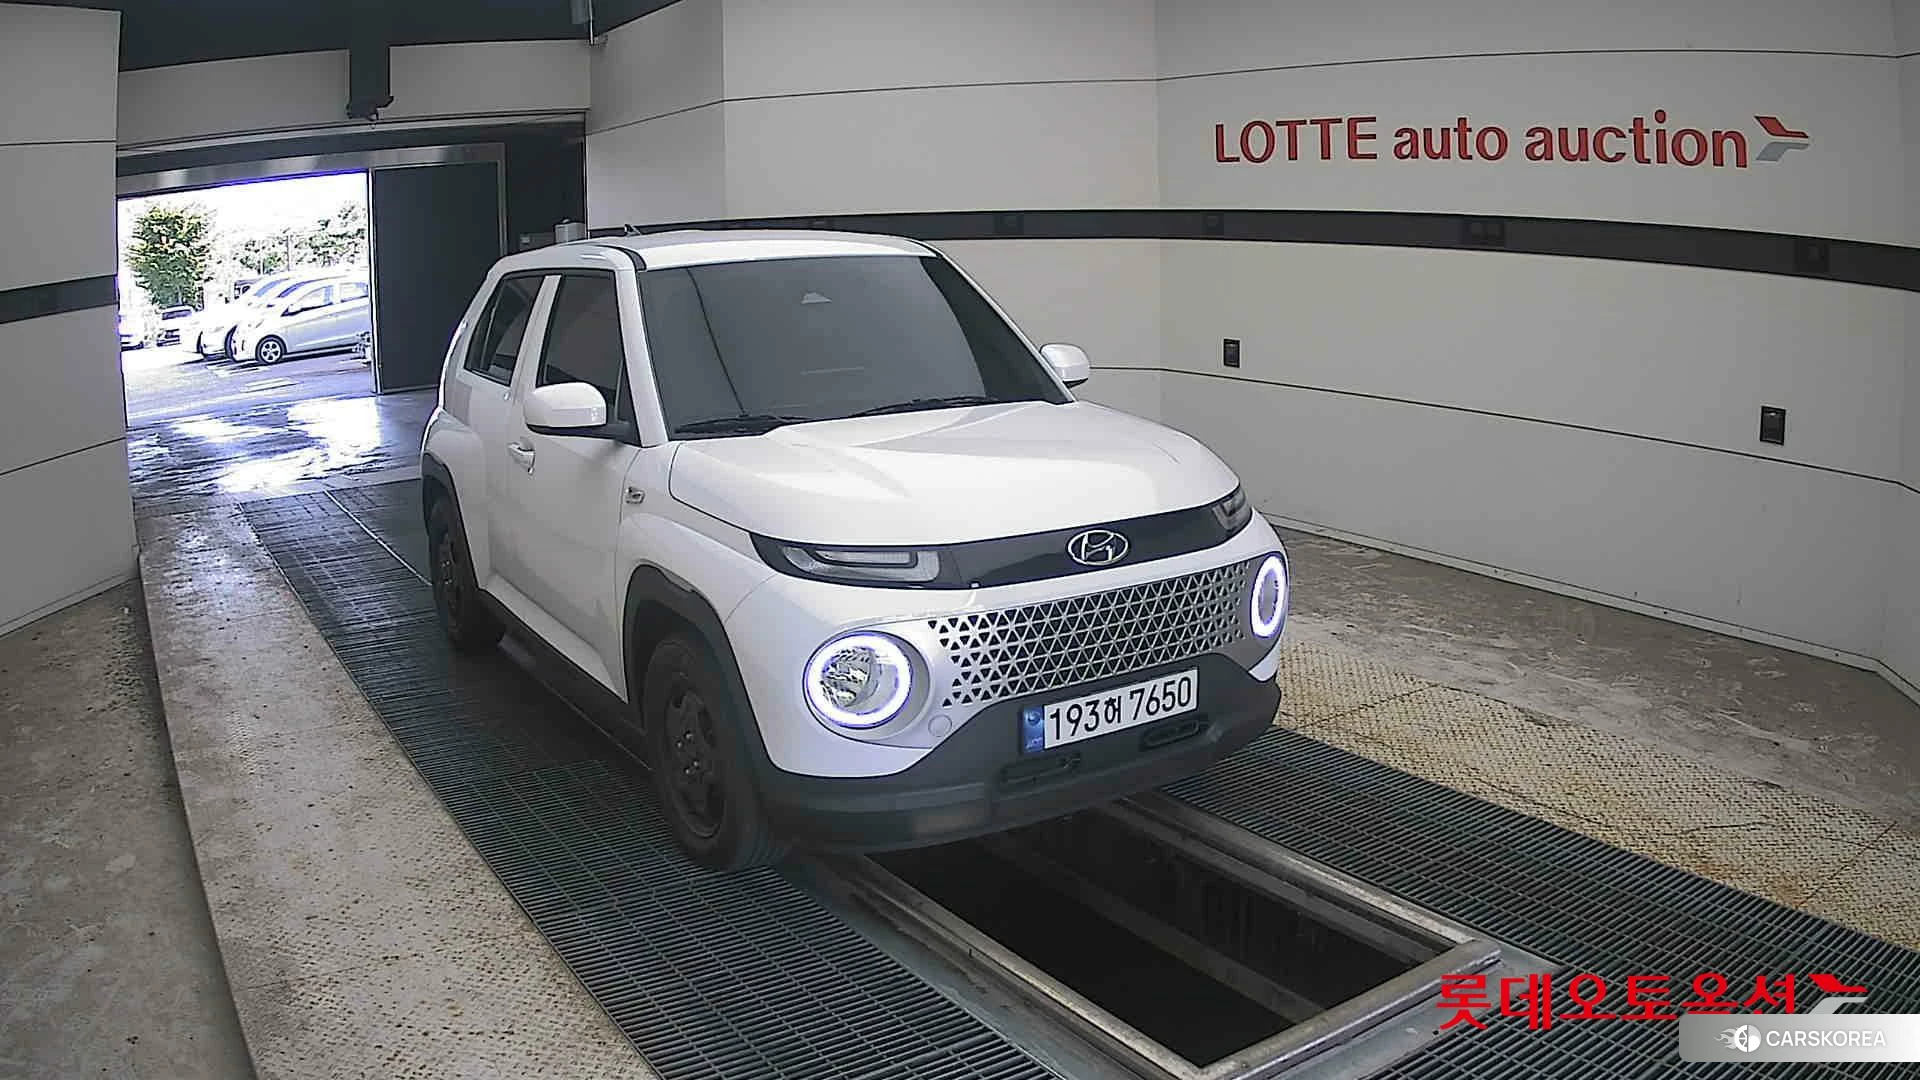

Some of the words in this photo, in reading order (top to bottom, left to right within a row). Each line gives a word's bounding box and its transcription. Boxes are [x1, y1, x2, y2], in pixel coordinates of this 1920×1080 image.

[1214, 116, 1378, 164] LOTTE
[1392, 116, 1509, 162] auto
[1524, 108, 1748, 169] auction
[1049, 695, 1122, 741] 193허
[1129, 676, 1192, 721] 7650
